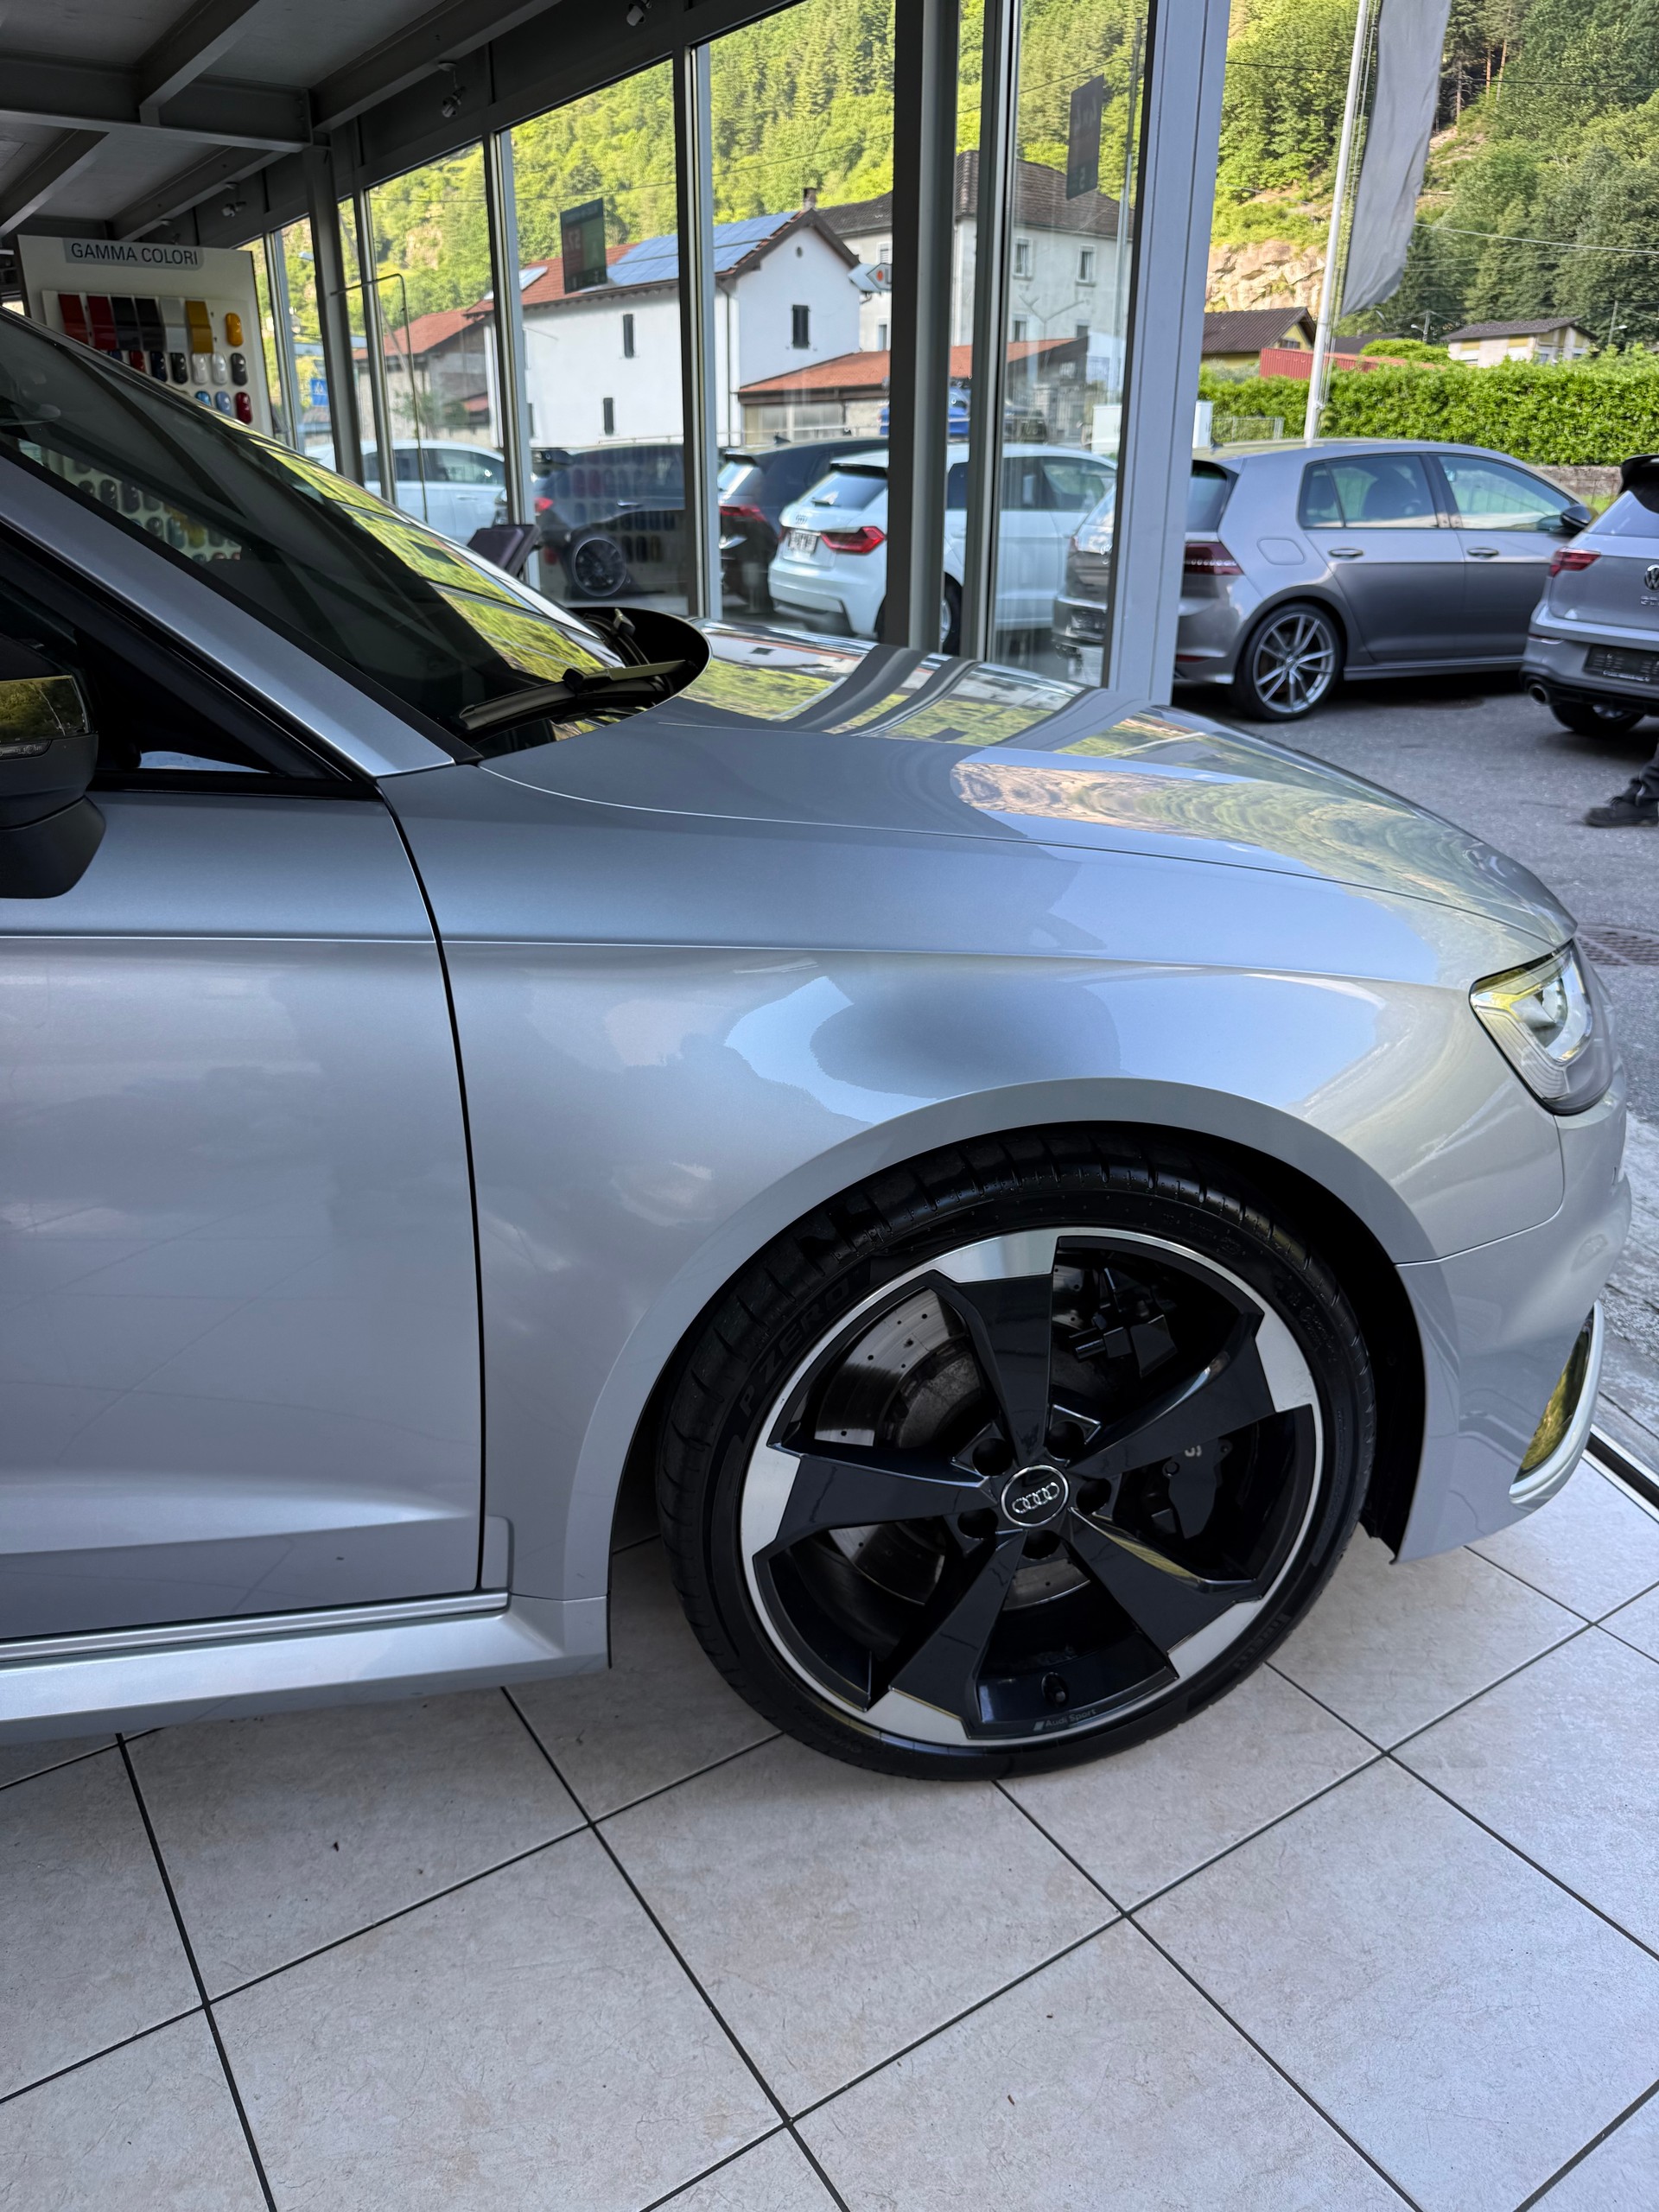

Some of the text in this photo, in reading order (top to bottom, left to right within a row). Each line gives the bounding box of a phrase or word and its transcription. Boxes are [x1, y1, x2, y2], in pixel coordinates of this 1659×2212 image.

[71, 242, 198, 265] GAMMA COLORI
[739, 1277, 850, 1418] P ZERO
[1046, 1709, 1096, 1727] Audi Sport
